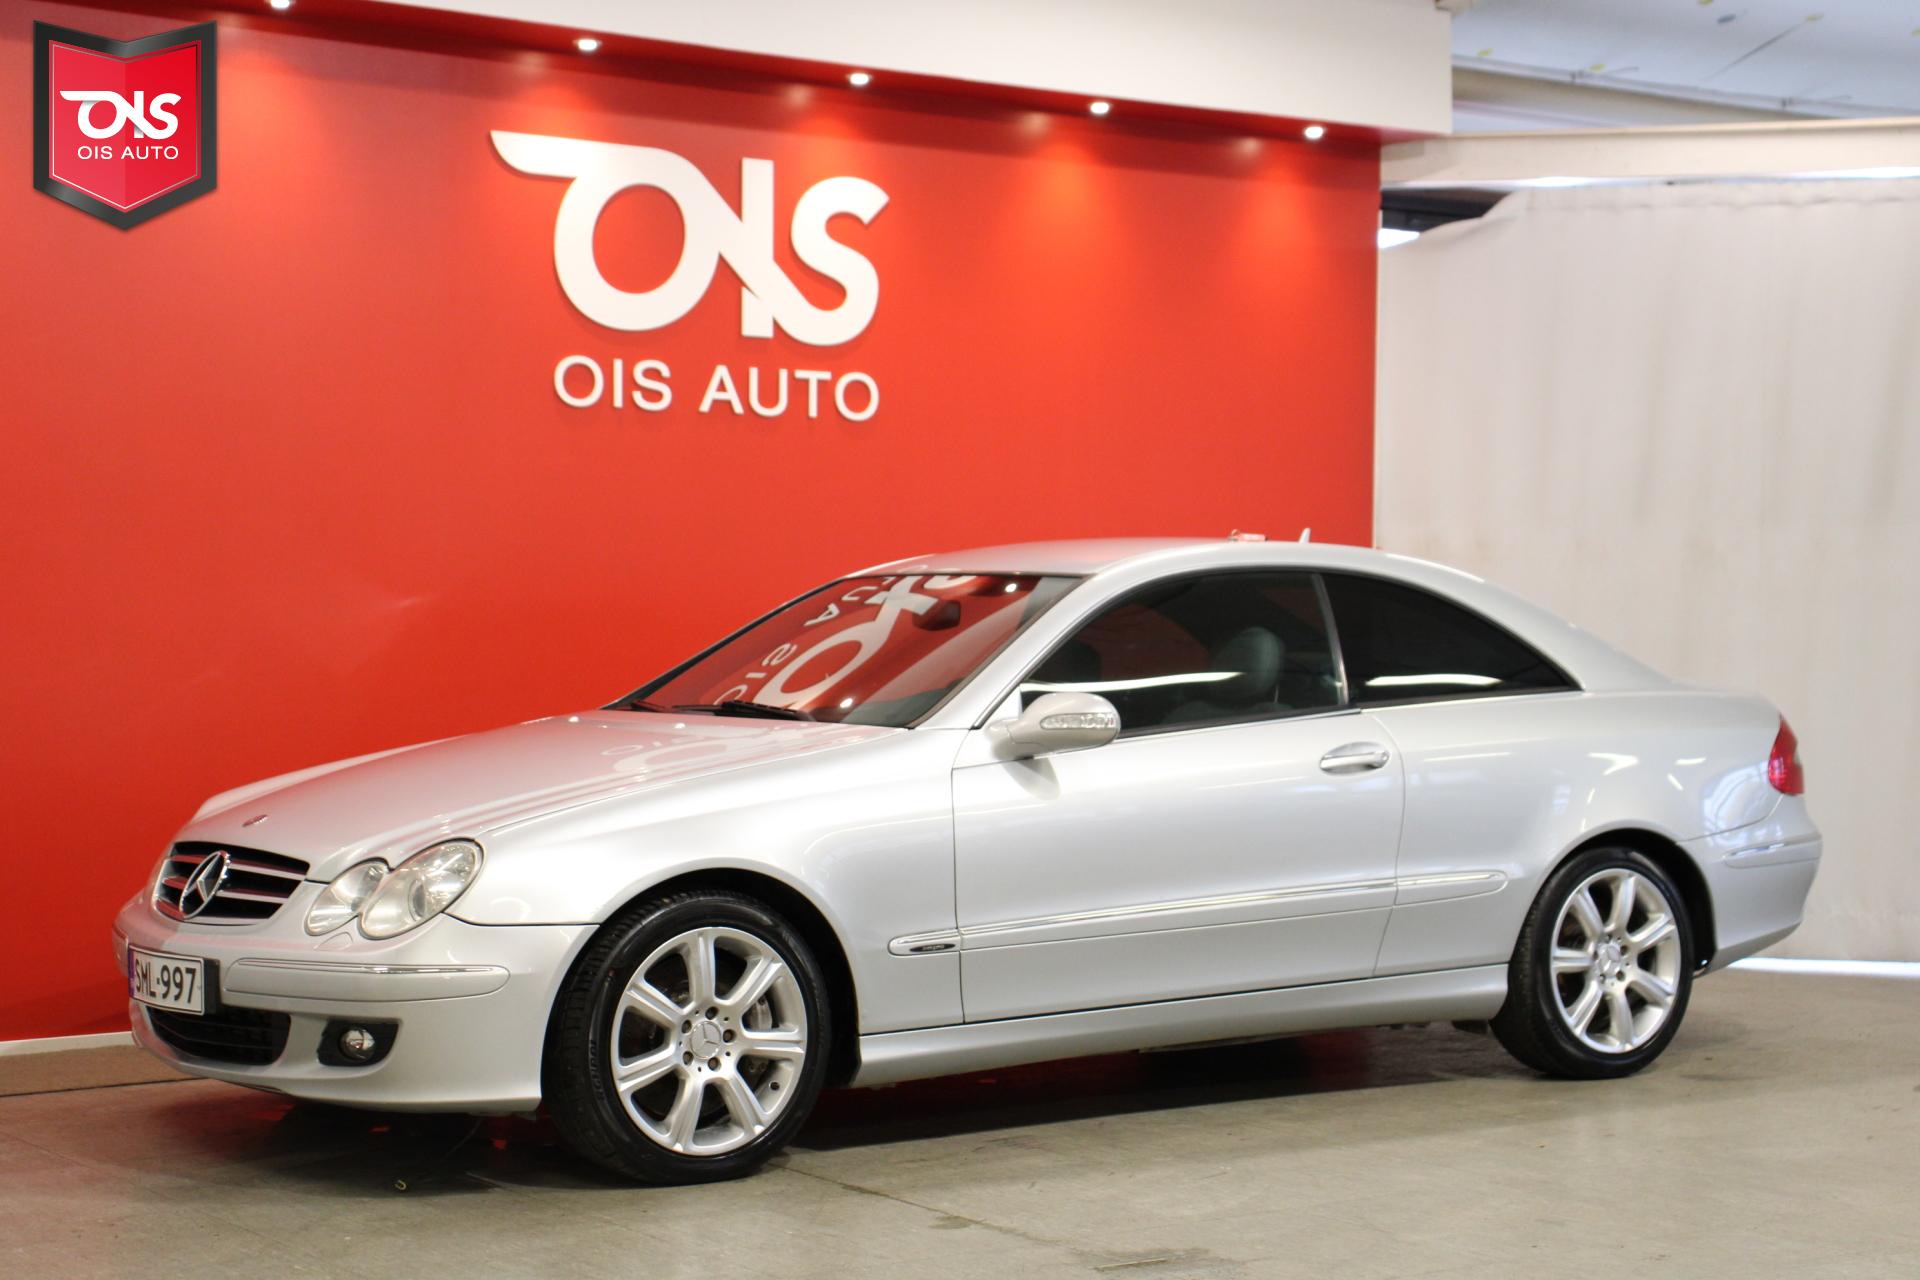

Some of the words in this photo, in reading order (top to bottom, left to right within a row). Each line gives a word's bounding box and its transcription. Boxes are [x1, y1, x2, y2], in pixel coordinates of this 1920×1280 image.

[490, 130, 890, 346] OIS
[553, 355, 673, 412] OIS
[699, 365, 880, 422] AUTO
[135, 958, 197, 1004] SML-997
